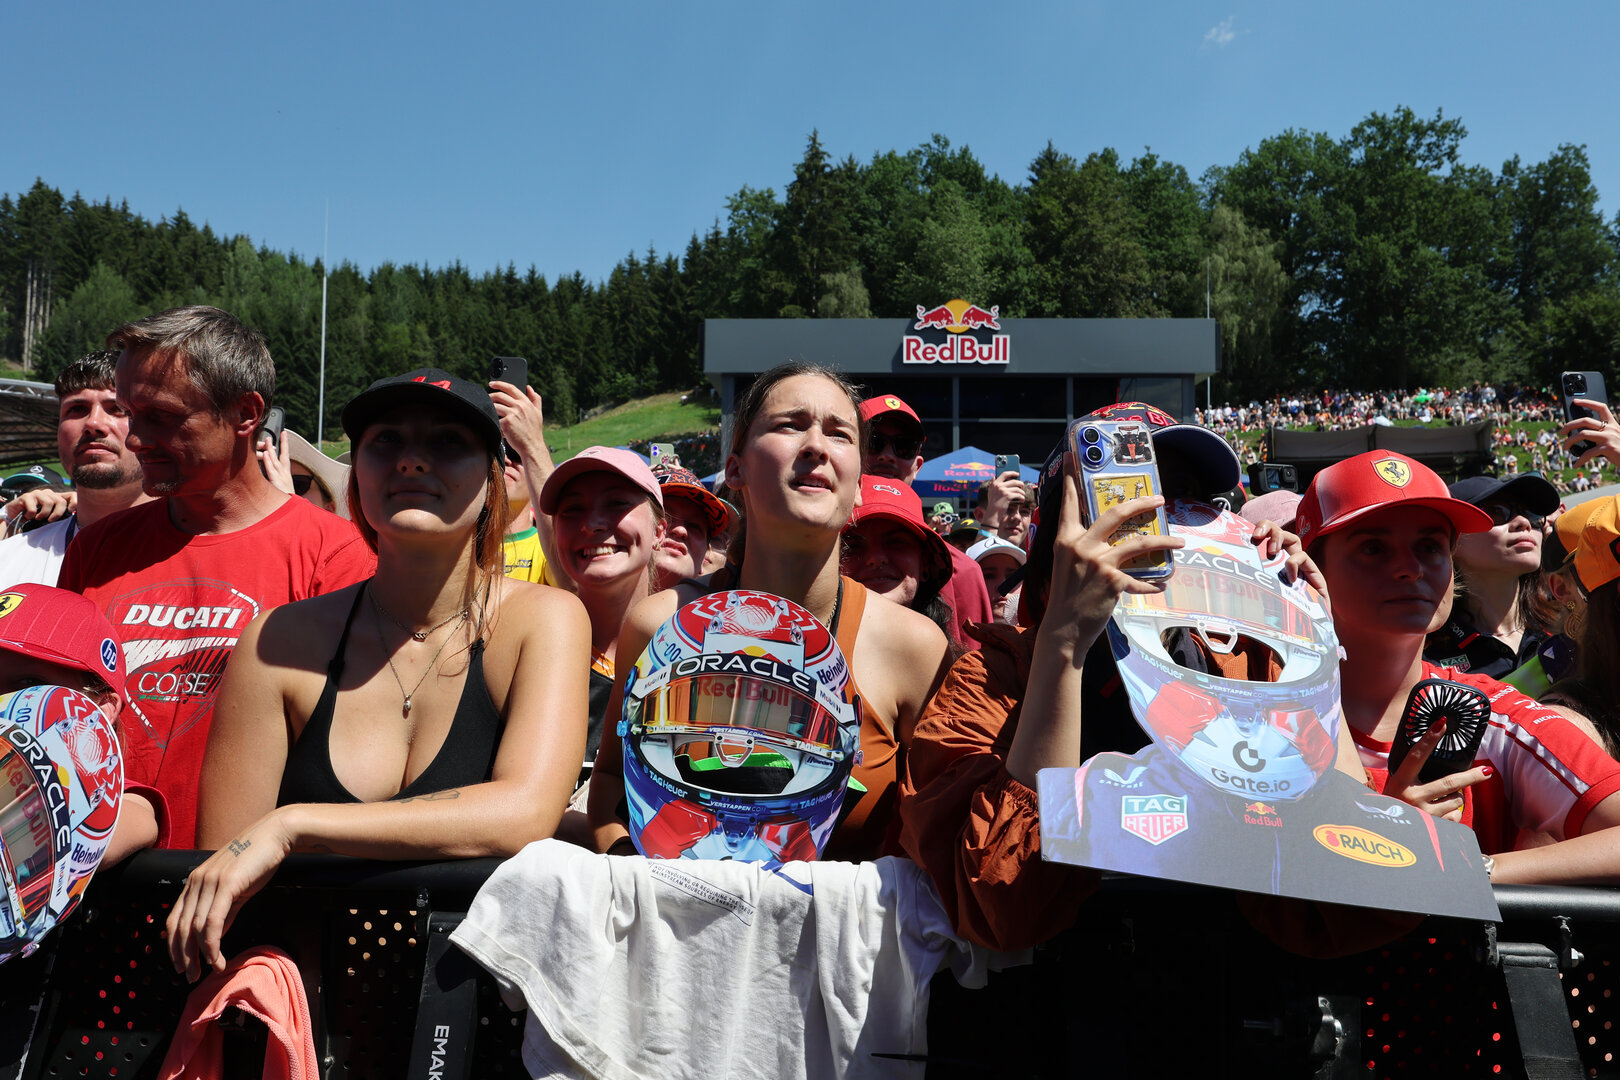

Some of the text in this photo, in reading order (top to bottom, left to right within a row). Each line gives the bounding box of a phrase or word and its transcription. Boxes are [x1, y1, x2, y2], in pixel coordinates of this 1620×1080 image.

[904, 335, 1009, 362] Red Bull
[944, 469, 977, 477] Red
[1173, 550, 1275, 590] RACLE
[121, 604, 243, 629] DUCATI
[103, 639, 118, 668] hp
[1442, 656, 1466, 667] TAG
[675, 655, 811, 692] ORACLE
[697, 677, 791, 706] Red Bull
[9, 728, 71, 852] ORACLE
[1211, 767, 1291, 793] Gate.io
[1127, 798, 1181, 812] TAG
[1126, 815, 1185, 840] HEUER
[1243, 814, 1284, 828] Red Bull
[1339, 833, 1405, 862] RAUCH
